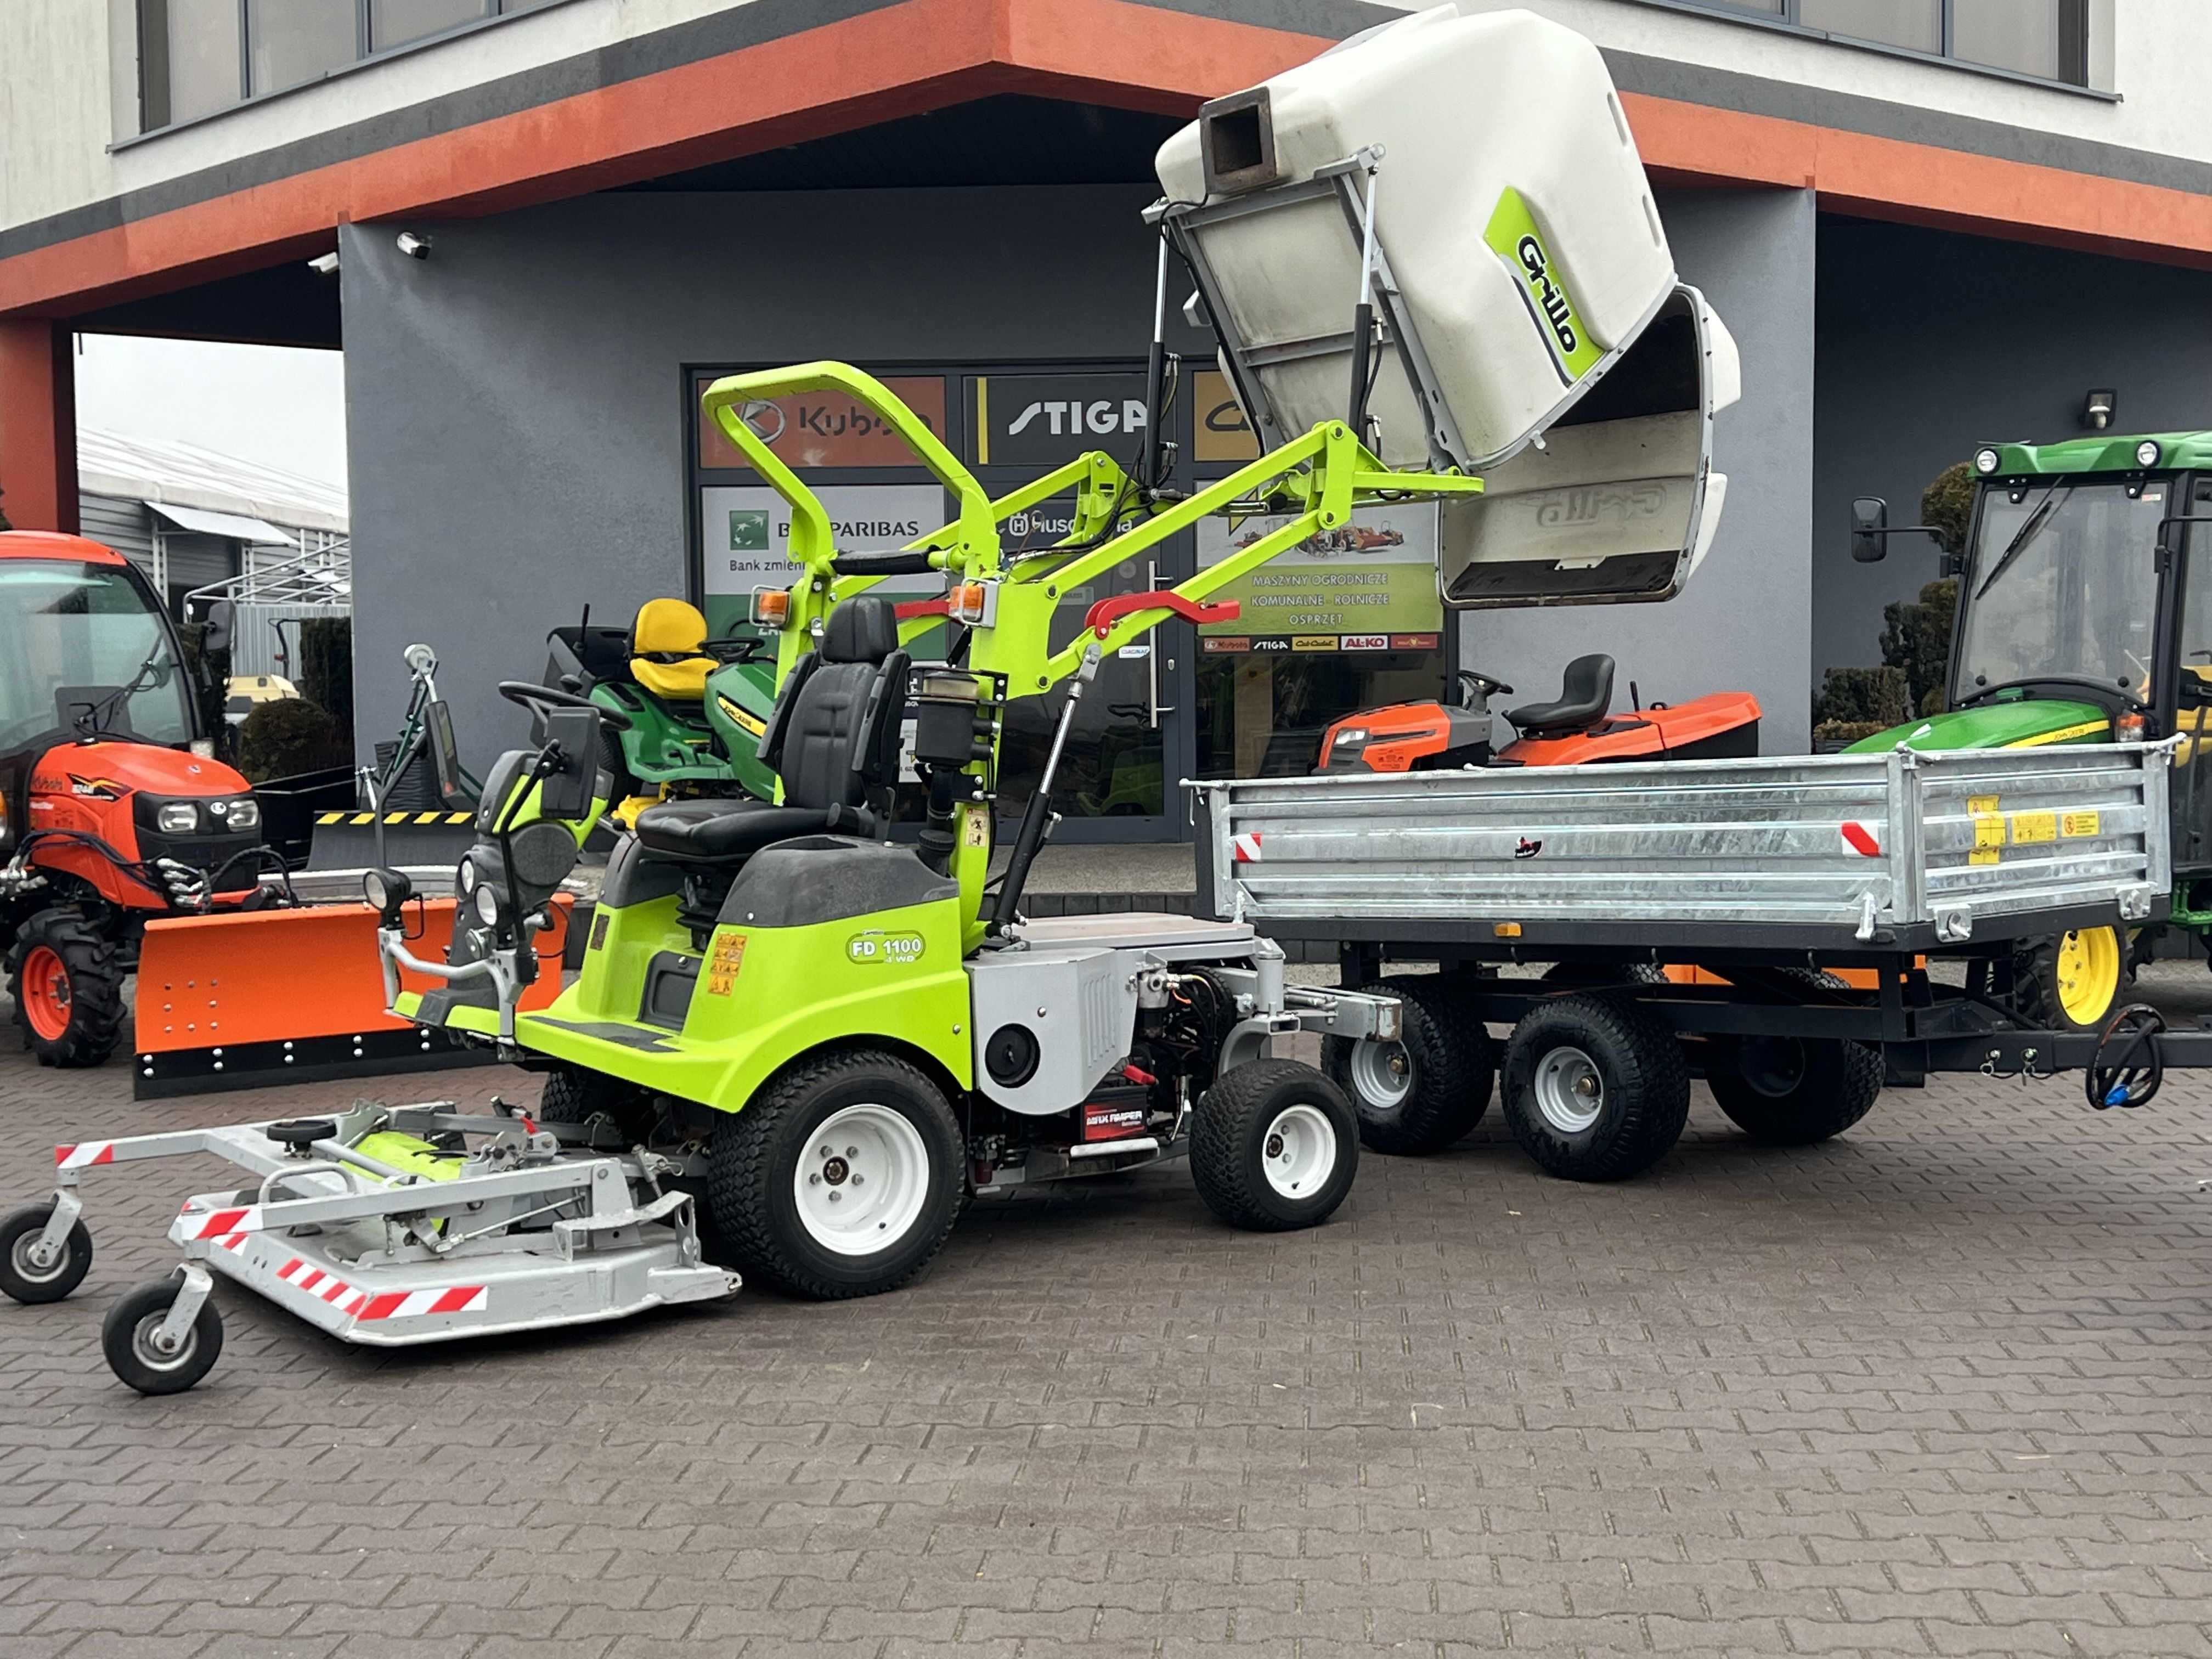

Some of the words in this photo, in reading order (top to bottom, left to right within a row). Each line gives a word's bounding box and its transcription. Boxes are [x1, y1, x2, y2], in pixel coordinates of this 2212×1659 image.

[1517, 234, 1577, 353] Grillo
[730, 560, 760, 571] Bank
[1252, 574, 1308, 586] MASZYNY
[1312, 573, 1387, 585] OGRODNICZE
[1251, 594, 1324, 606] KOMUNALNE
[1334, 594, 1389, 605] ROLNICZE
[1289, 614, 1343, 625] OSPRZĘT
[1254, 641, 1289, 650] STIGA
[853, 941, 876, 956] FD
[883, 938, 922, 954] 1100
